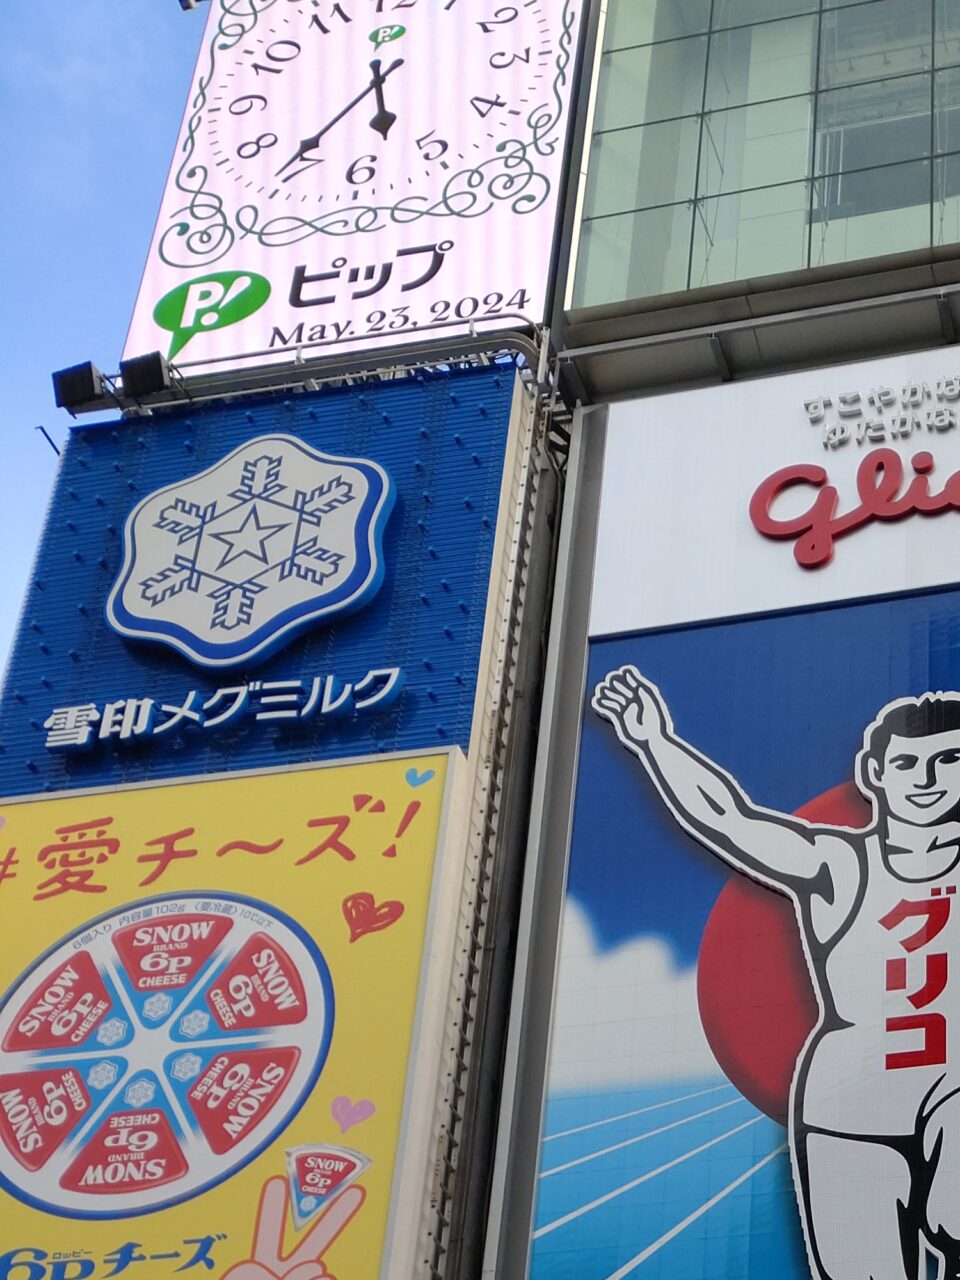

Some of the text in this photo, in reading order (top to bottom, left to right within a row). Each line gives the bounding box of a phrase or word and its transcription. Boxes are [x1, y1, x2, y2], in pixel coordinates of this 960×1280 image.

[476, 7, 518, 33] 2
[251, 40, 301, 76] 10
[489, 47, 530, 70] 3
[229, 94, 267, 115] 9
[470, 94, 508, 117] 4
[237, 133, 278, 159] 8
[415, 129, 448, 161] 5
[345, 154, 378, 184] 6
[288, 239, 454, 308] ピップ
[268, 288, 531, 348] May. 23, 2024
[43, 667, 400, 748] 雪印メグミルク
[133, 921, 215, 946] SNOW
[138, 973, 187, 988] CHEESE
[251, 948, 300, 1010] SNOW
[877, 885, 957, 1071] グリコ
[18, 965, 79, 1037] SNOW
[210, 988, 236, 1028] CHEESE
[71, 1000, 109, 1042] CHEESE
[190, 1056, 229, 1100] CHEESE
[222, 1062, 285, 1139] SNOW
[0, 1088, 43, 1153] SNOW
[109, 1113, 160, 1128] CHEESE
[78, 1159, 166, 1186] SNOW
[304, 1156, 347, 1172] SNOW
